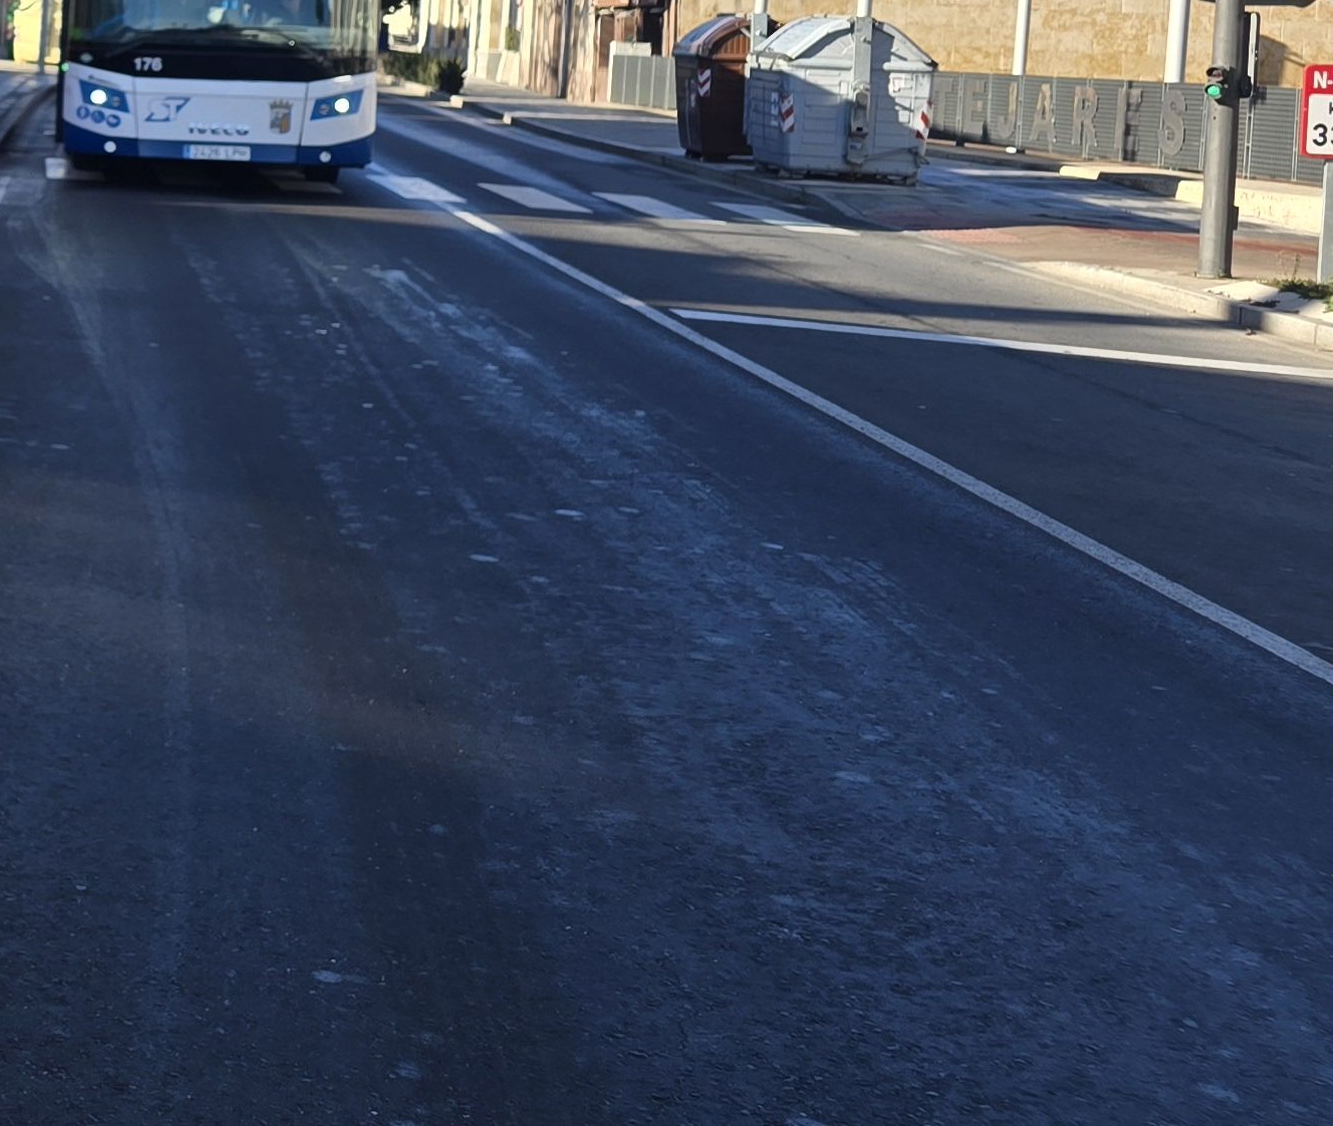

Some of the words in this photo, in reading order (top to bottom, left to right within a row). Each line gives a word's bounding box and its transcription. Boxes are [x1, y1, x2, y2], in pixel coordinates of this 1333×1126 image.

[133, 57, 163, 72] 176
[933, 77, 1188, 156] TEJARES
[1312, 123, 1333, 147] 3
